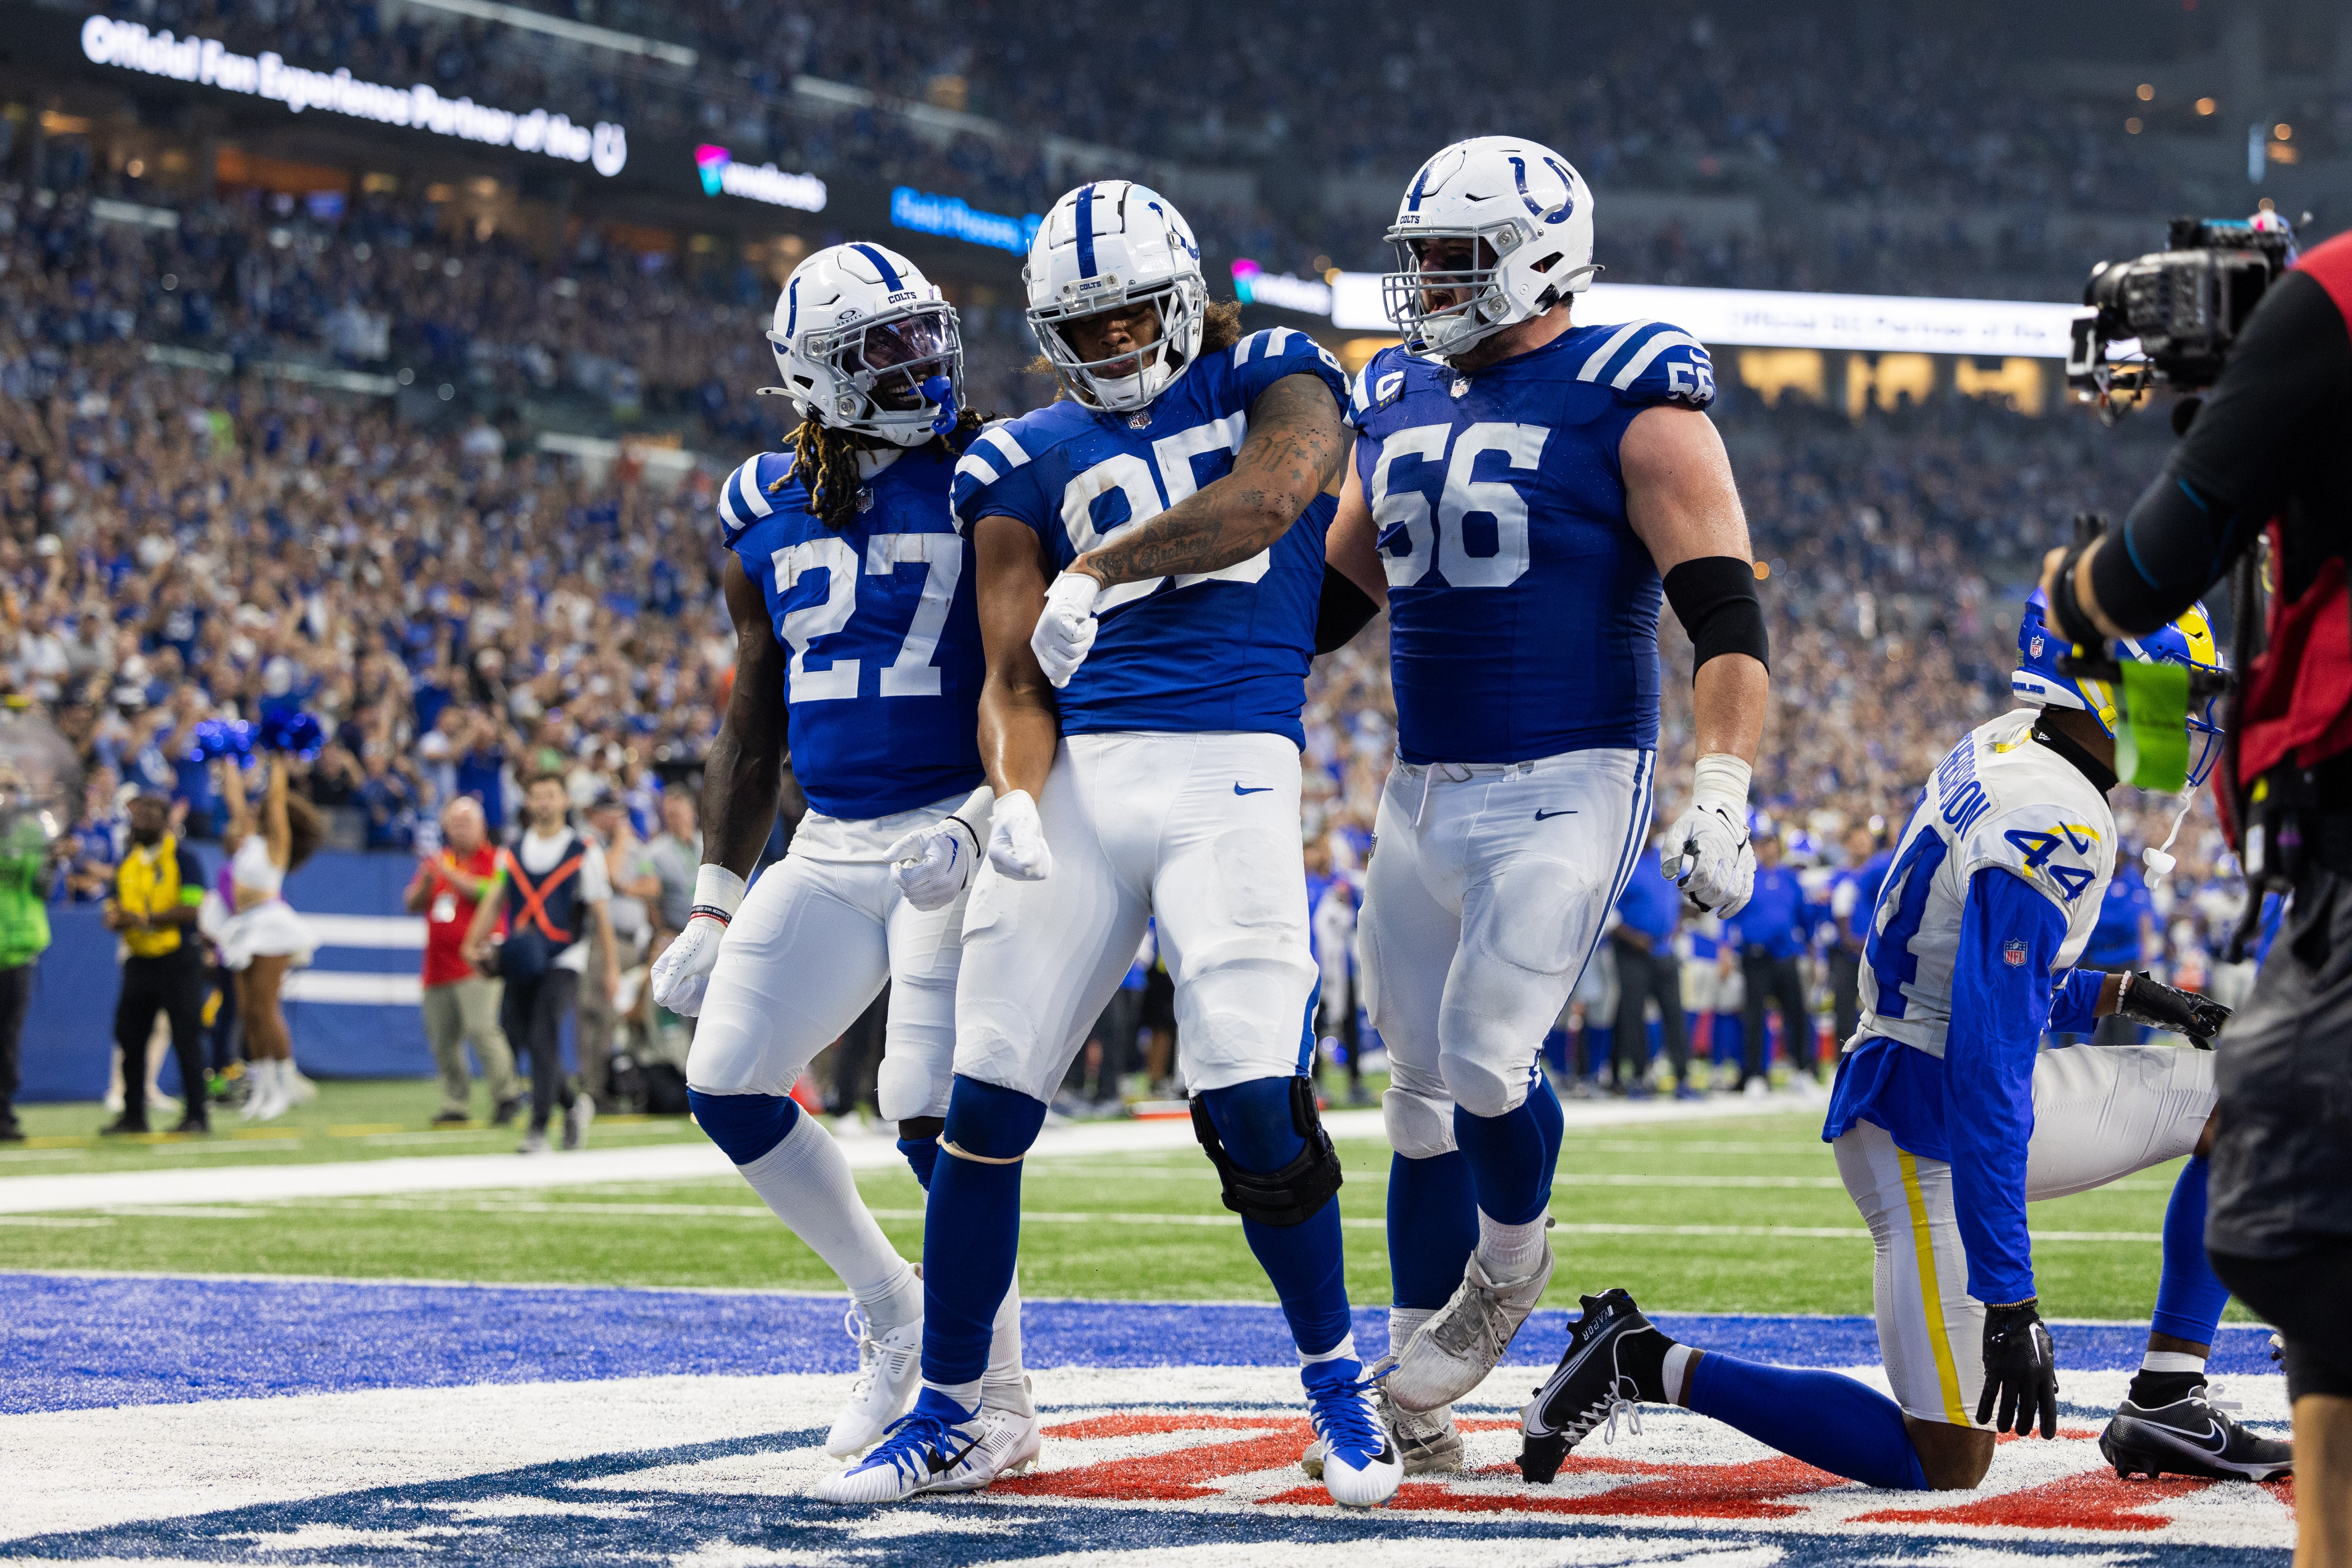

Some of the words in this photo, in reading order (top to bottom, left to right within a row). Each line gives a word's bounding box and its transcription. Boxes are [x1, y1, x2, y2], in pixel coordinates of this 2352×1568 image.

[1400, 215, 1420, 224] COLTS
[1079, 281, 1101, 290] COLTS
[888, 292, 917, 304] COLTS
[837, 313, 863, 327] OAKLEY
[1376, 371, 1404, 401] C
[1132, 417, 1148, 426] NFL
[1372, 422, 1551, 588] 56
[771, 532, 963, 704] 27
[2031, 645, 2040, 655] NFL
[2004, 829, 2096, 903] 44
[1865, 786, 1949, 1019] 4
[712, 908, 726, 918] WHEN
[2006, 951, 2024, 964] NFL
